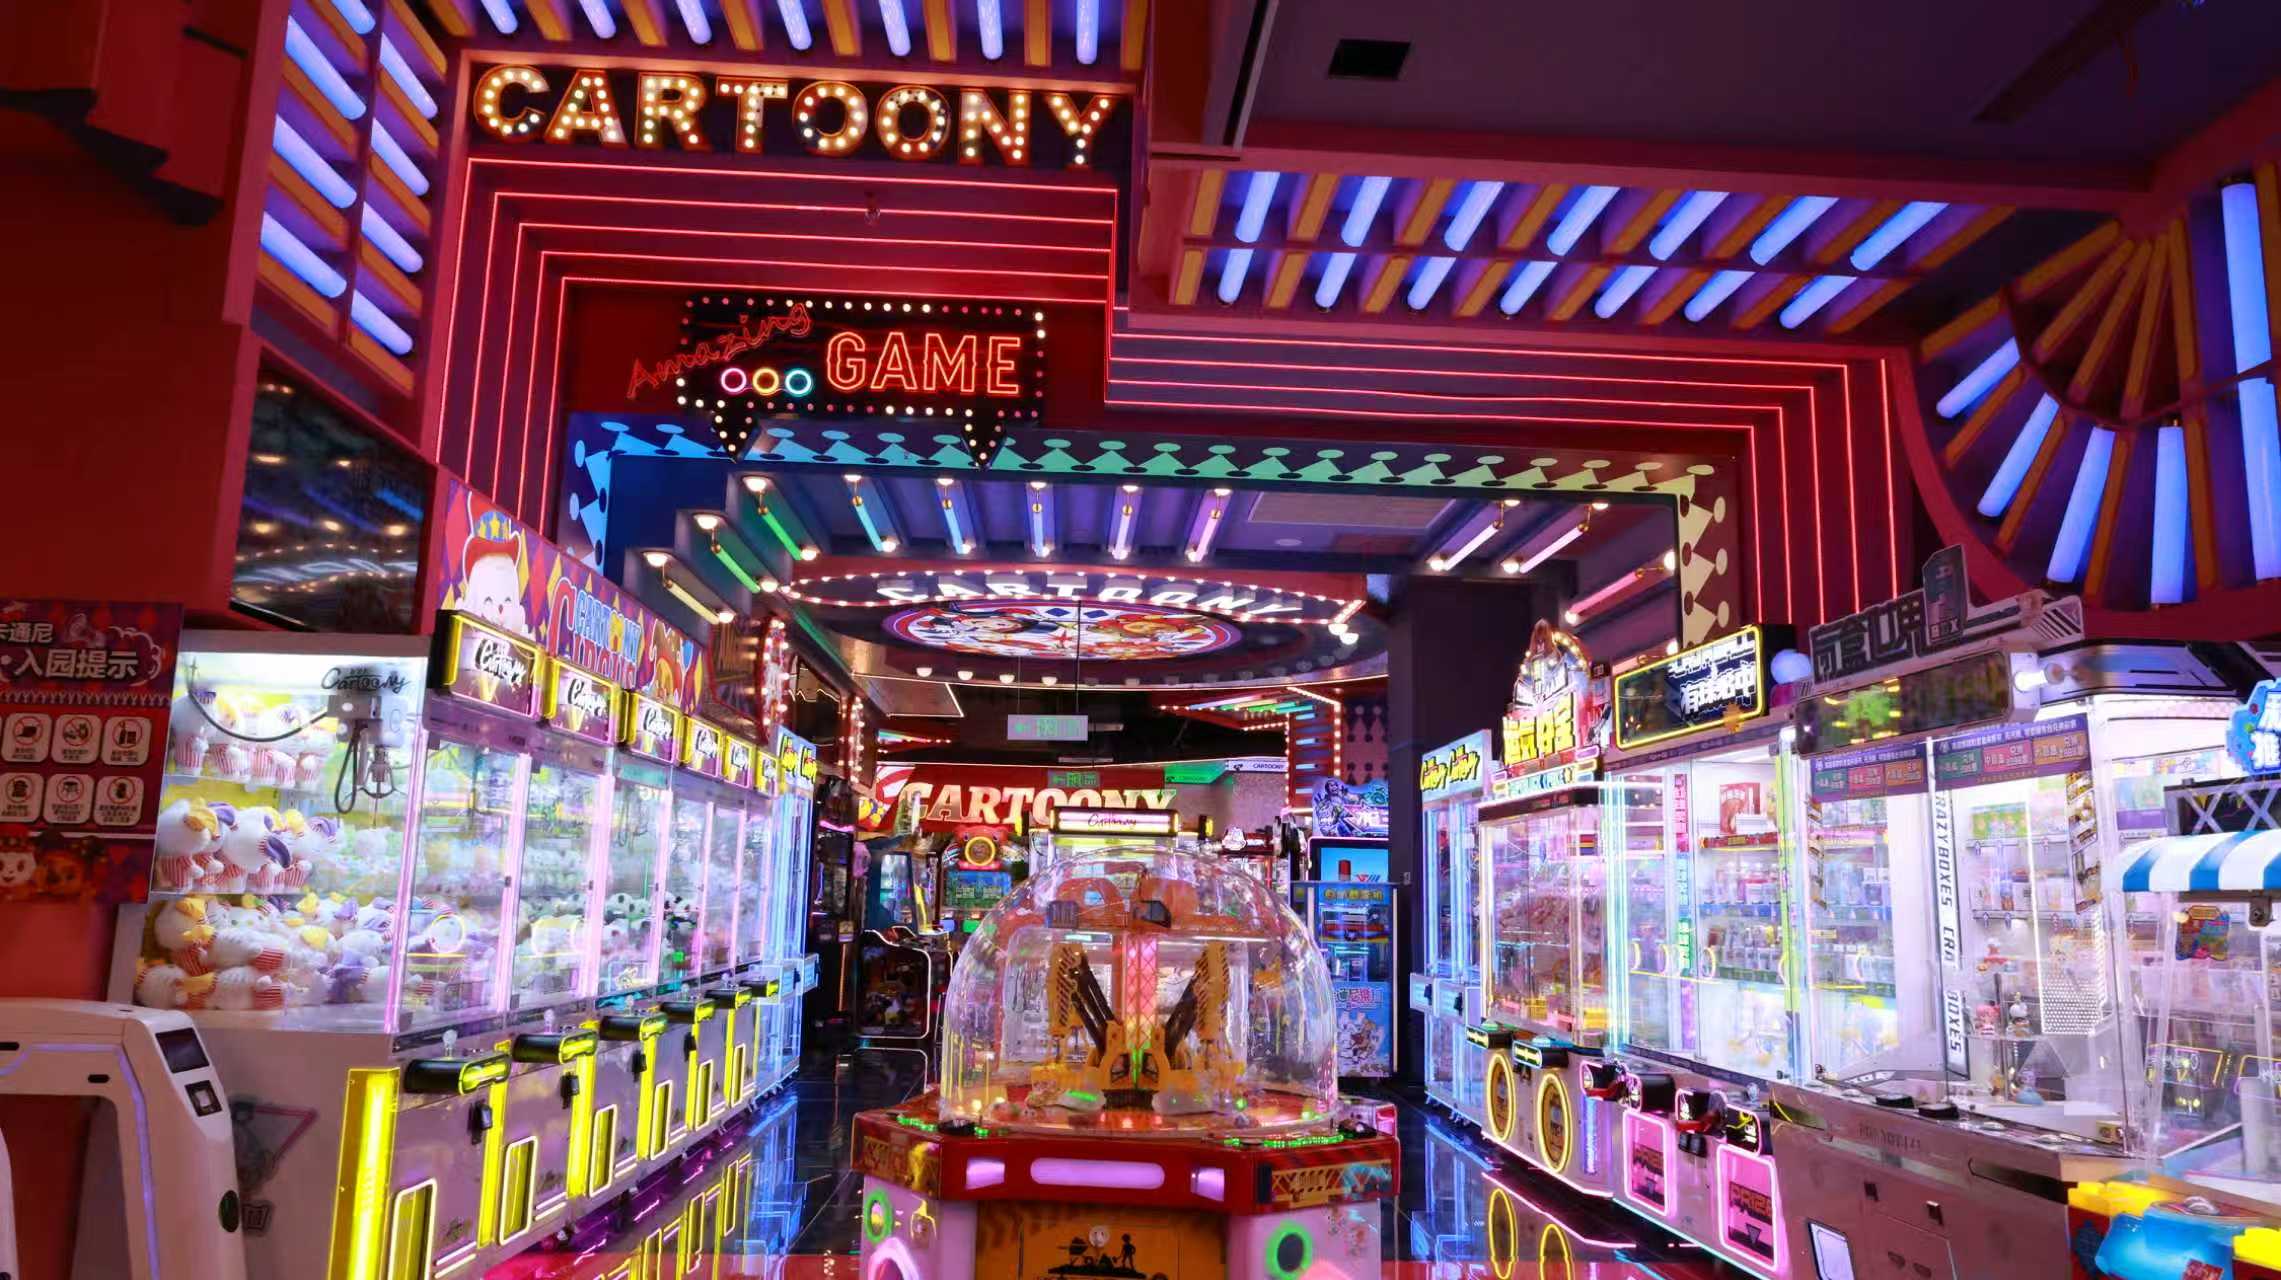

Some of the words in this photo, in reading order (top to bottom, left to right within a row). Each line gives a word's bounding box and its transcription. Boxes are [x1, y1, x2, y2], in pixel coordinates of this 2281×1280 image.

[473, 63, 1112, 168] CARTOONY
[626, 302, 812, 398] Amazing
[826, 331, 1021, 396] GAME
[877, 580, 1303, 617] CARTOONY
